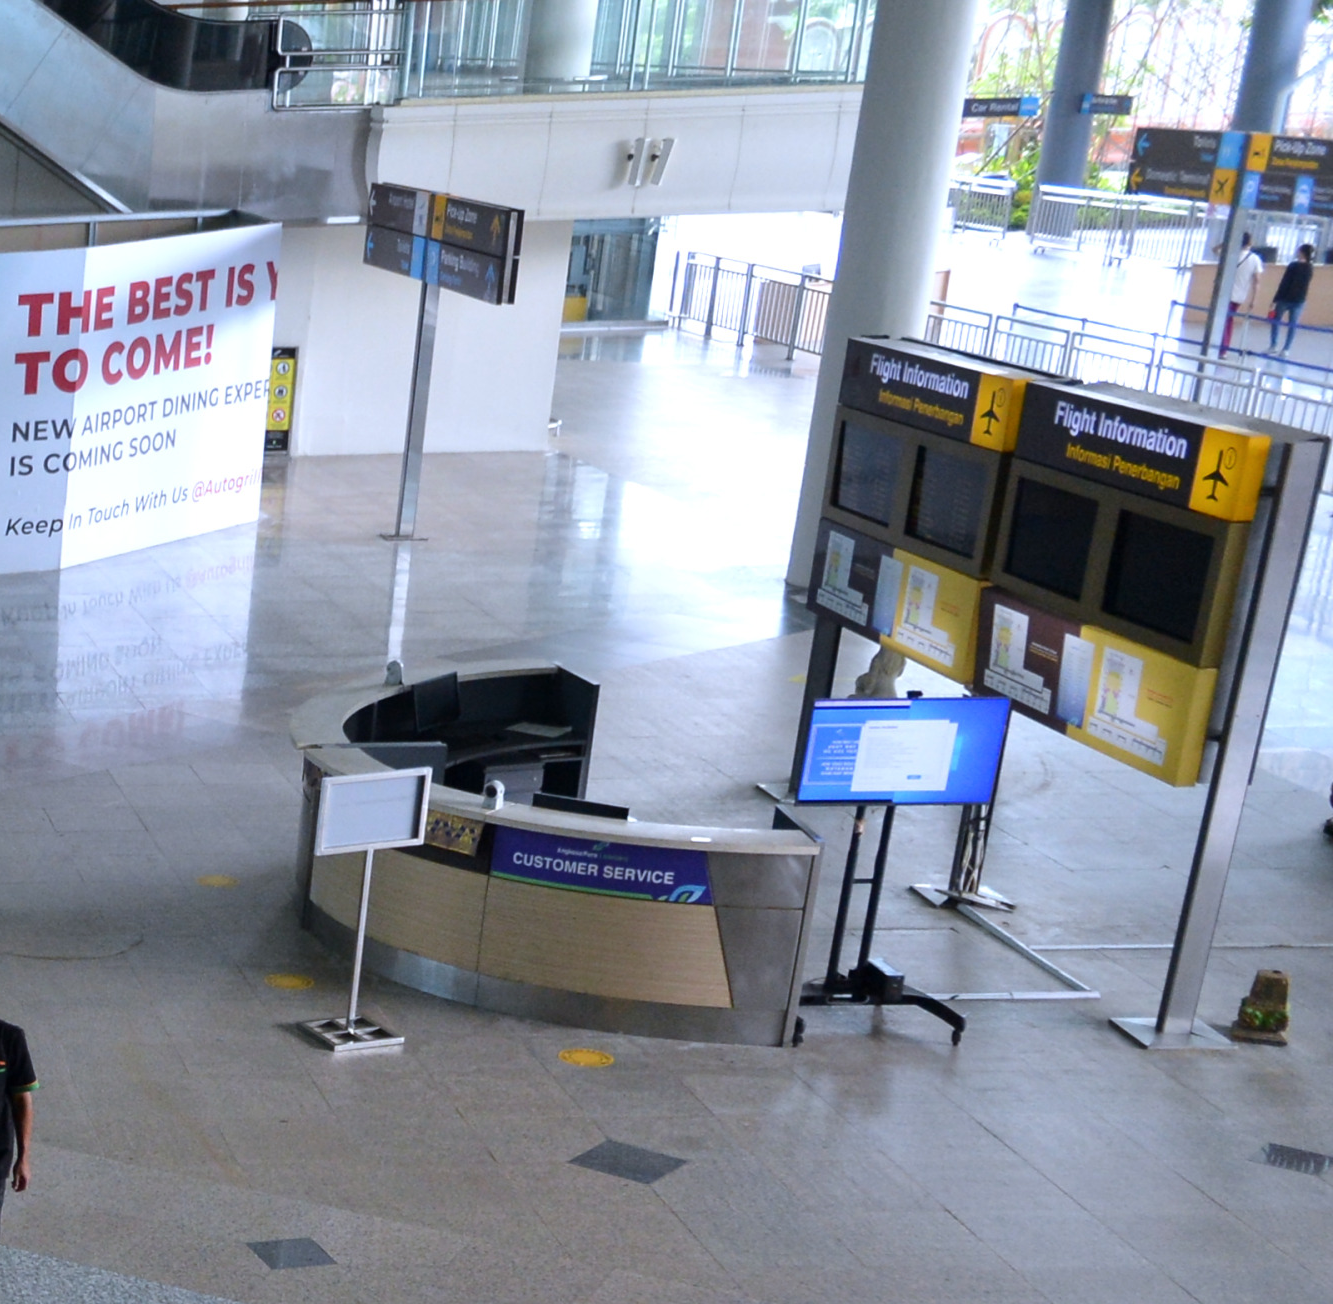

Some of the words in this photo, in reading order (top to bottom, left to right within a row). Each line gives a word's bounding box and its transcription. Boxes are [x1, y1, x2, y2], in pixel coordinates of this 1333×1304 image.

[18, 285, 116, 337] THE
[127, 268, 216, 325] BEST
[225, 263, 255, 308] IS
[14, 348, 89, 395] TO
[101, 324, 215, 386] COME!
[869, 353, 905, 384] Flight
[902, 361, 970, 400] Information
[11, 417, 76, 443] NEW
[81, 401, 157, 436] AIRPORT
[162, 388, 219, 418] DINING
[1054, 400, 1095, 437] Flight
[1097, 412, 1188, 459] Information
[9, 455, 34, 477] IS
[43, 441, 123, 474] COMING
[129, 429, 177, 458] SOON
[1065, 442, 1112, 469] Informasi
[1112, 455, 1181, 490] Penerbangan
[4, 517, 64, 538] Keep
[68, 512, 82, 531] In
[88, 499, 130, 526] Touch
[135, 490, 168, 514] With
[171, 485, 189, 504] Us
[512, 851, 599, 877] CUSTOMER
[602, 865, 675, 885] SERVICE
